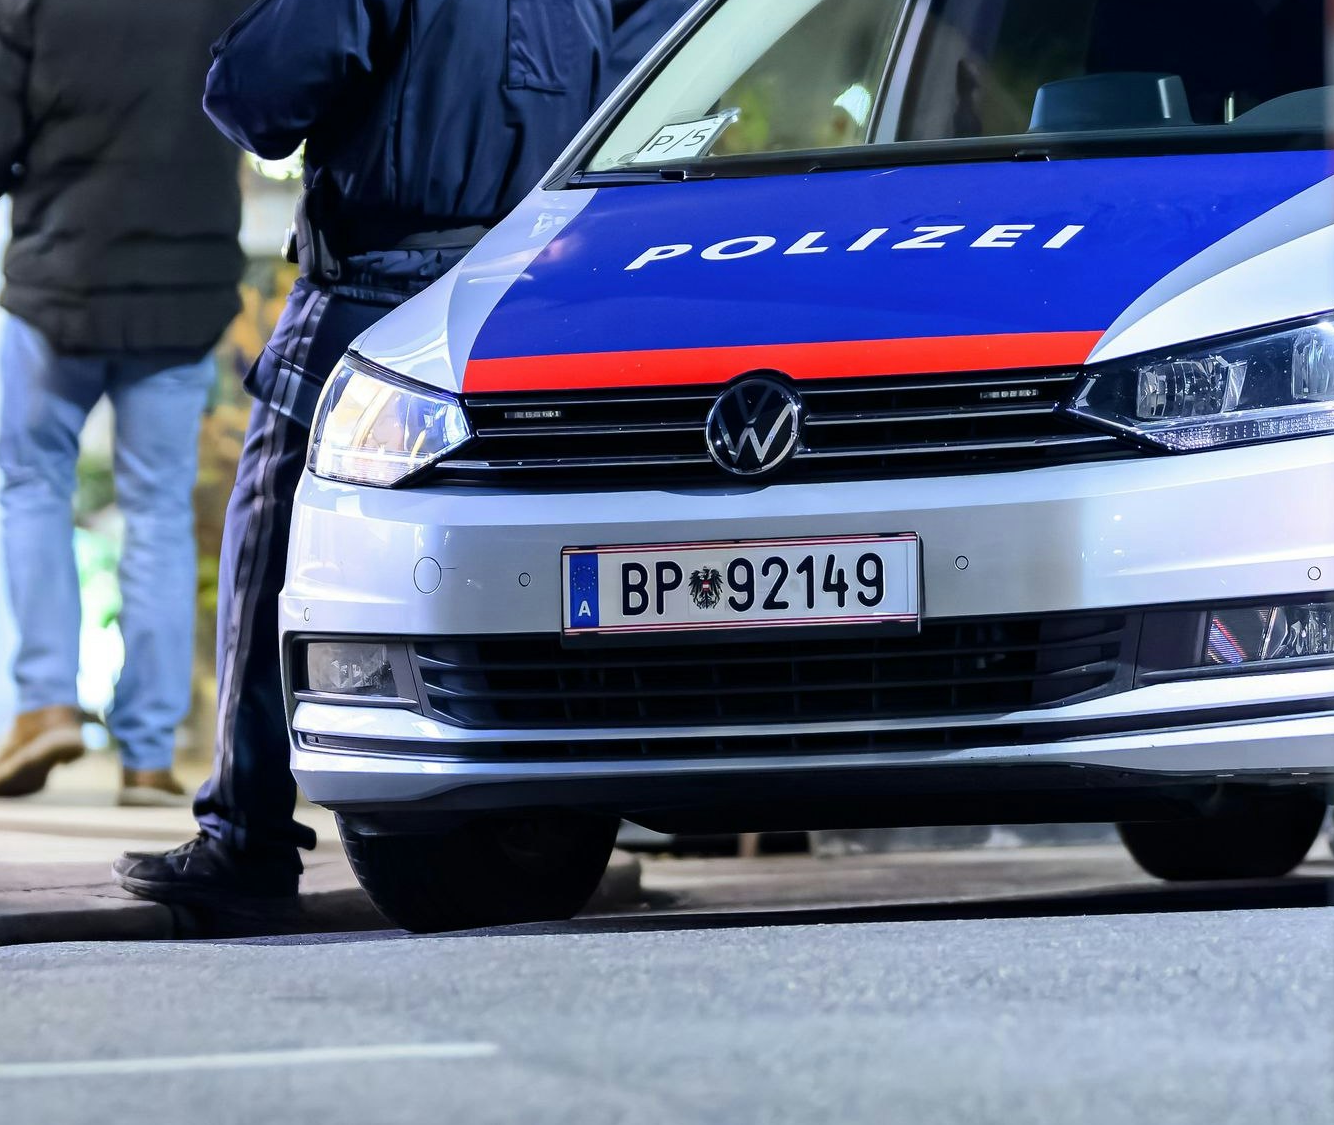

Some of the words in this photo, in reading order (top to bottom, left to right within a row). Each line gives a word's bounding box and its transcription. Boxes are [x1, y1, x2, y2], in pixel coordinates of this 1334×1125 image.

[647, 127, 712, 153] P/5
[623, 224, 1085, 271] POLIZEI
[577, 600, 592, 617] A
[621, 560, 683, 617] BP
[727, 552, 885, 613] 92149
